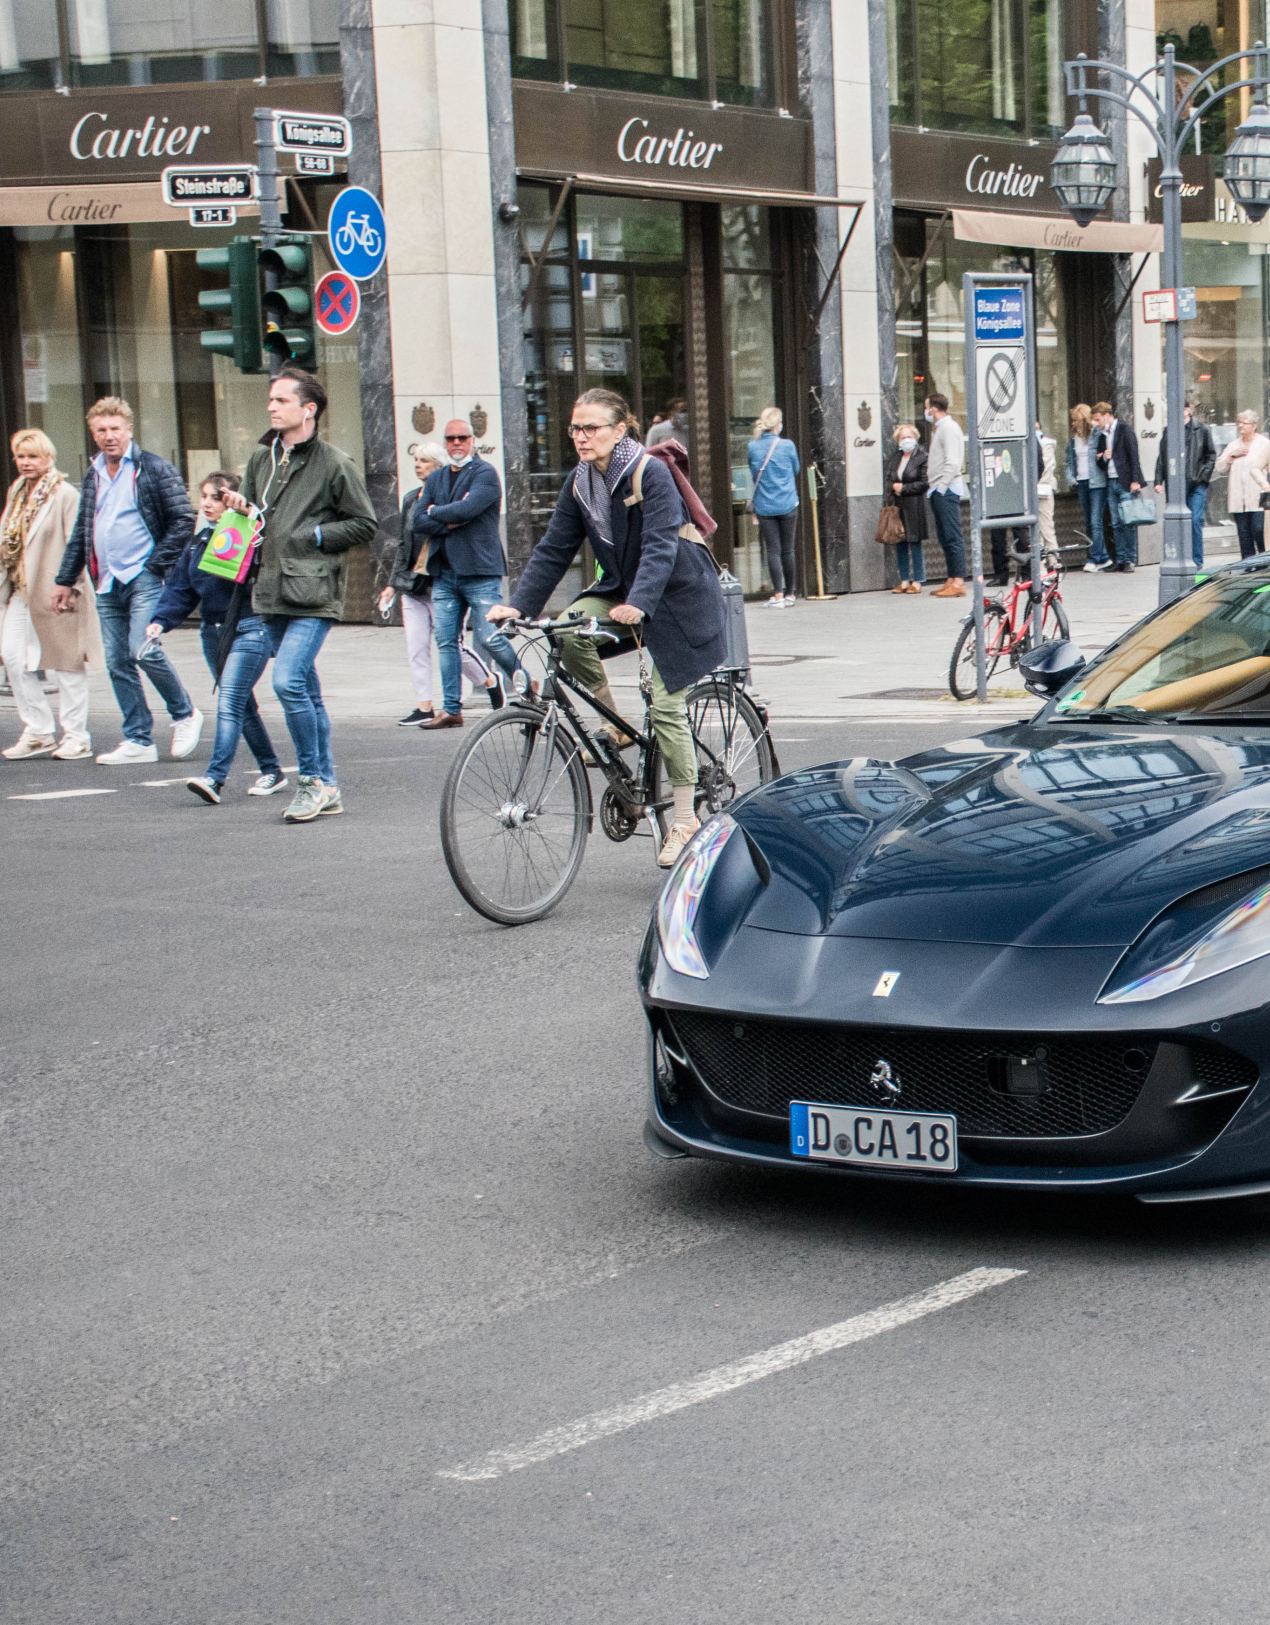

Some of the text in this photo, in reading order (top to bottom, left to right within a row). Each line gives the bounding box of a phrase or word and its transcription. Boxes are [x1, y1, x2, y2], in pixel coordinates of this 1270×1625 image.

[69, 112, 211, 160] Cartier
[285, 123, 343, 145] Königsallee
[617, 117, 724, 169] Cartier
[175, 177, 245, 196] Steinstraße
[965, 154, 1044, 198] Cartier
[1153, 183, 1204, 199] Ctier
[47, 191, 123, 222] Cartier
[1043, 222, 1085, 248] Cartier
[977, 299, 1020, 313] Blaue Zone
[976, 317, 1022, 333] Königsallee
[989, 418, 1015, 433] ZONE
[797, 1135, 805, 1147] D
[811, 1112, 832, 1151] D
